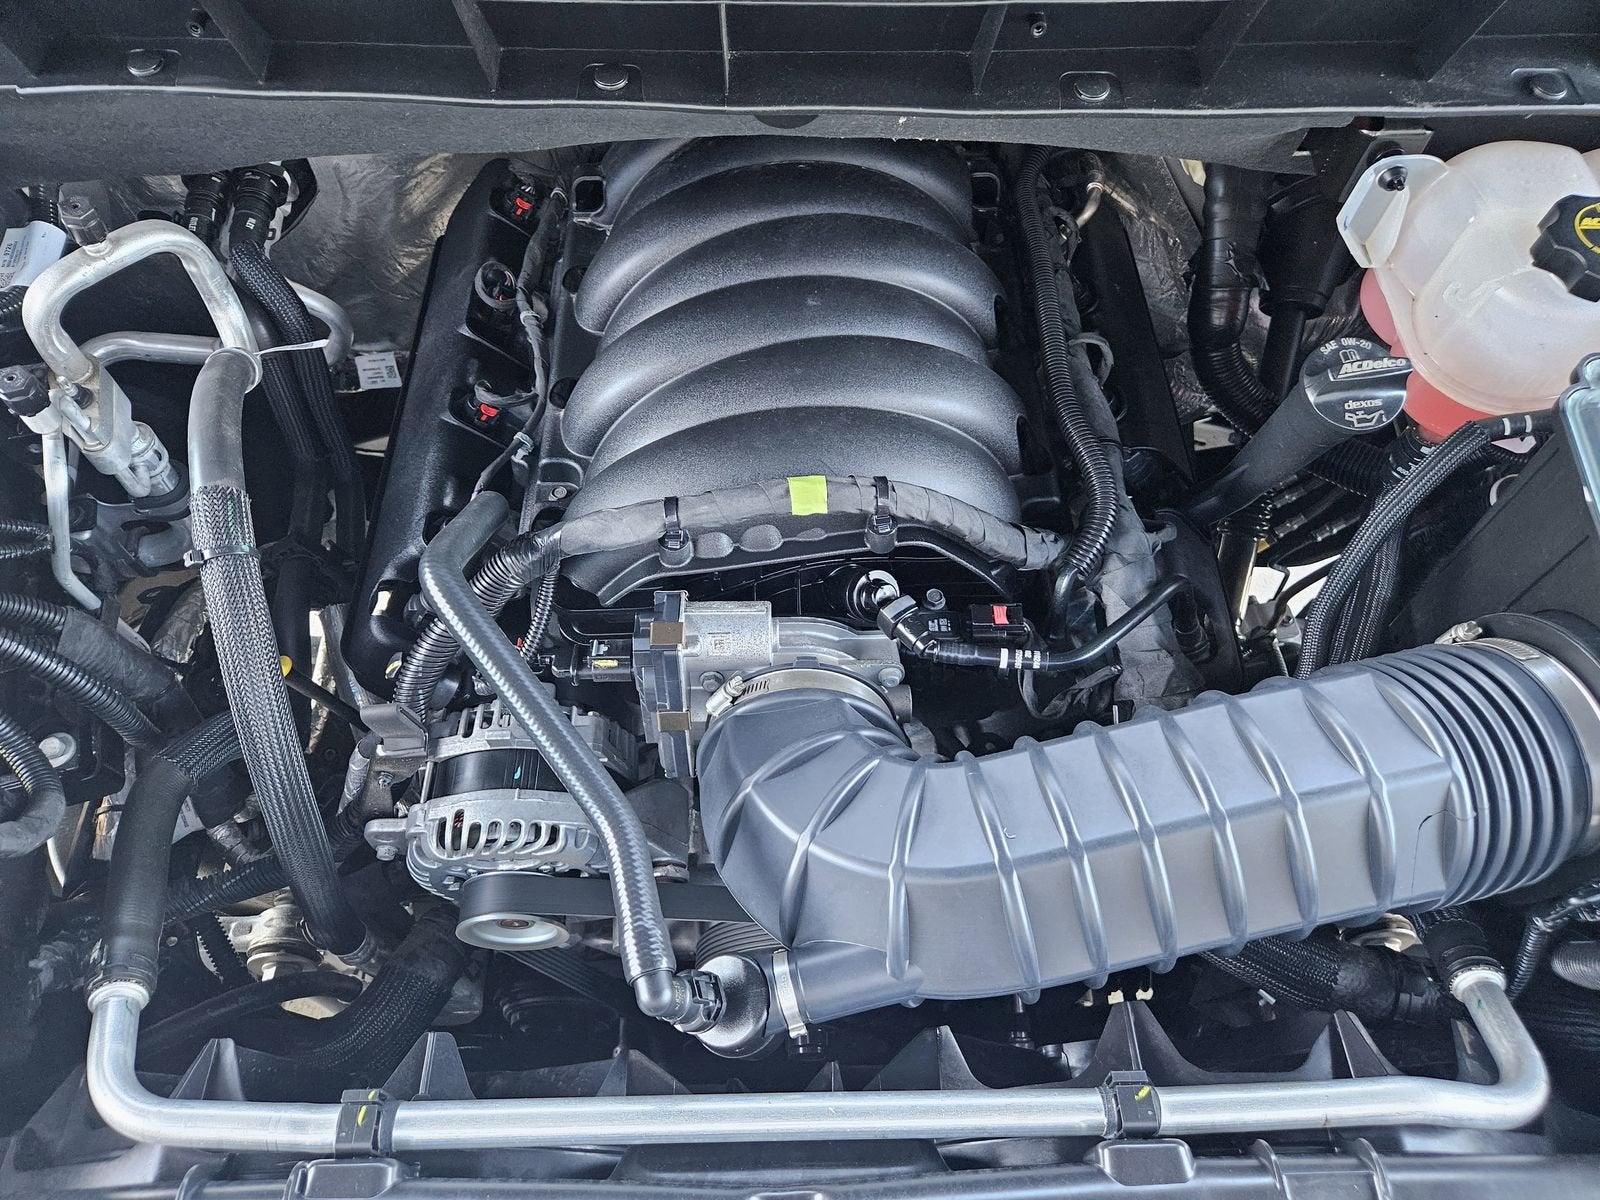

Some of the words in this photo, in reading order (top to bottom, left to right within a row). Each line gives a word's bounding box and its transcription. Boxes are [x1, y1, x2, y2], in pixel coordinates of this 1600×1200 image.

[1320, 340, 1339, 355] SAE
[1341, 337, 1372, 350] 0W-20
[1339, 357, 1406, 375] ACDelco
[1345, 399, 1383, 410] dexos
